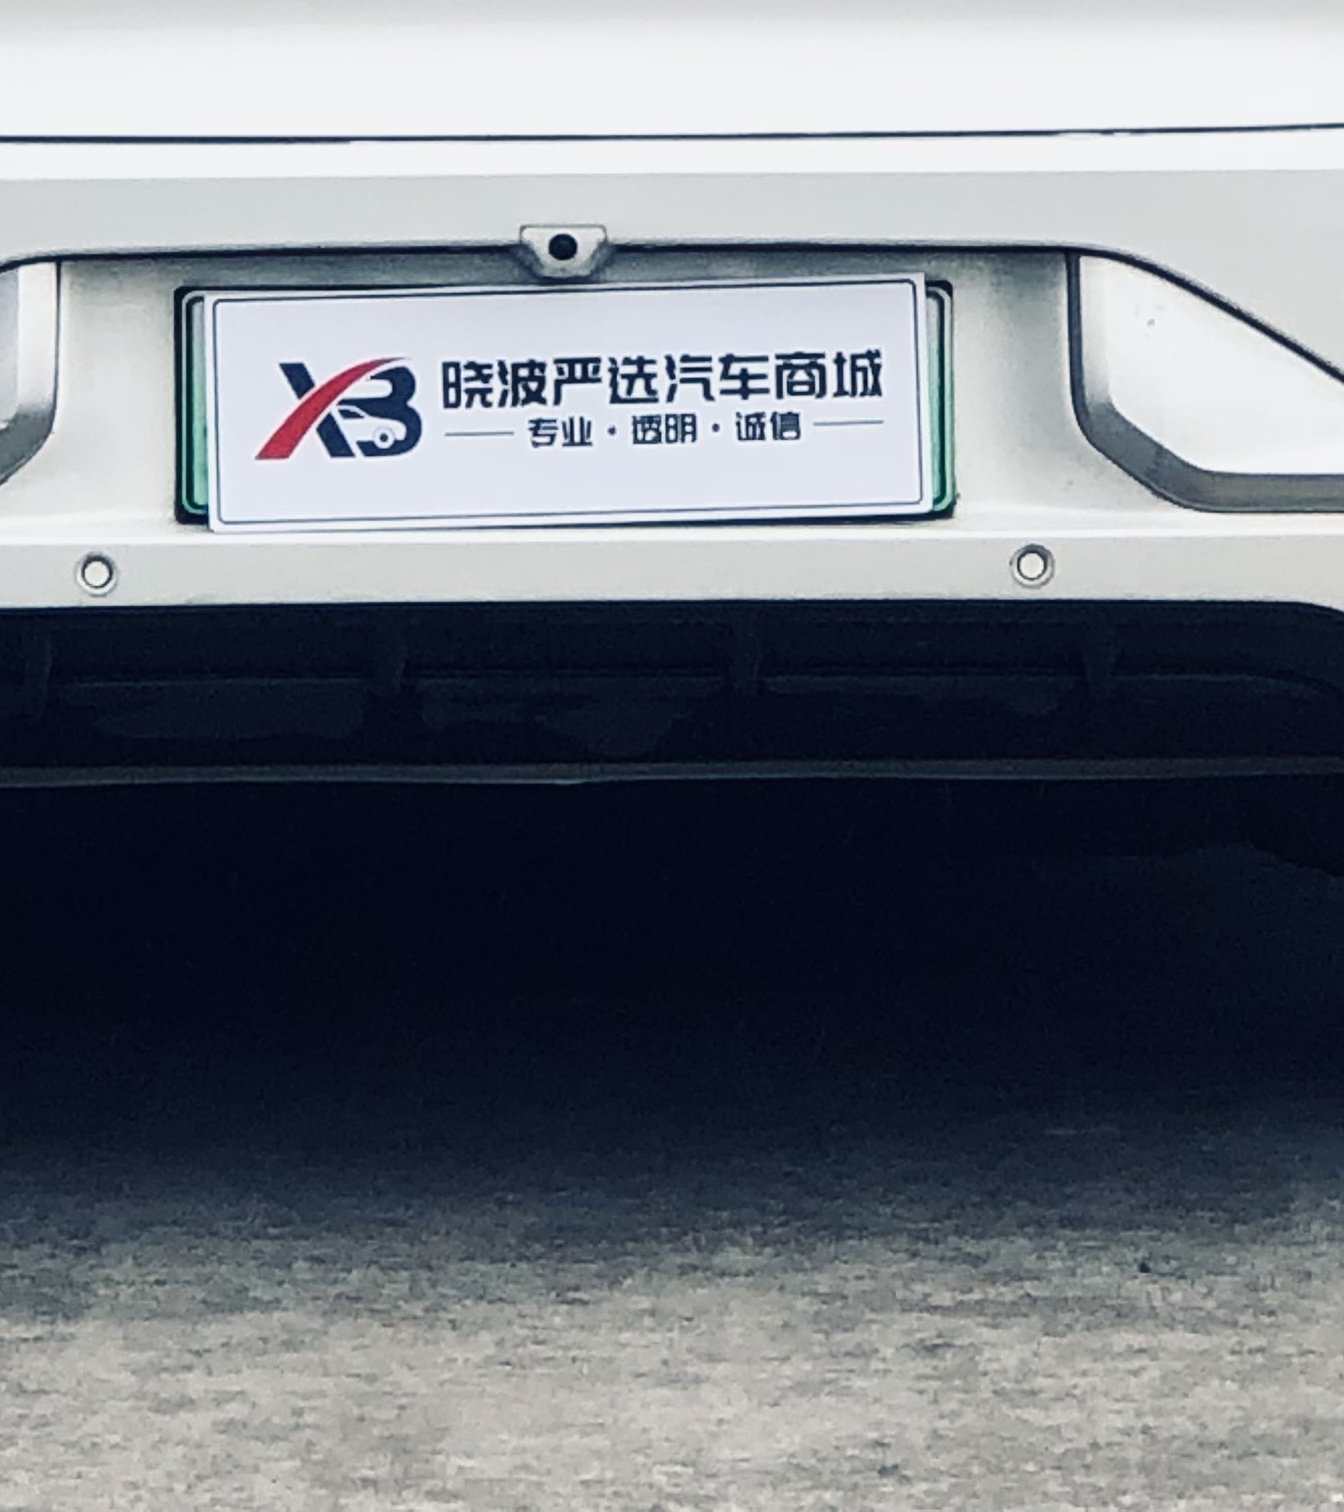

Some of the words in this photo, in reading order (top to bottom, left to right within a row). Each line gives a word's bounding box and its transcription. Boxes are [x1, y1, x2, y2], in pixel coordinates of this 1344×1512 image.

[441, 348, 883, 409] 晓波严选汽车商城
